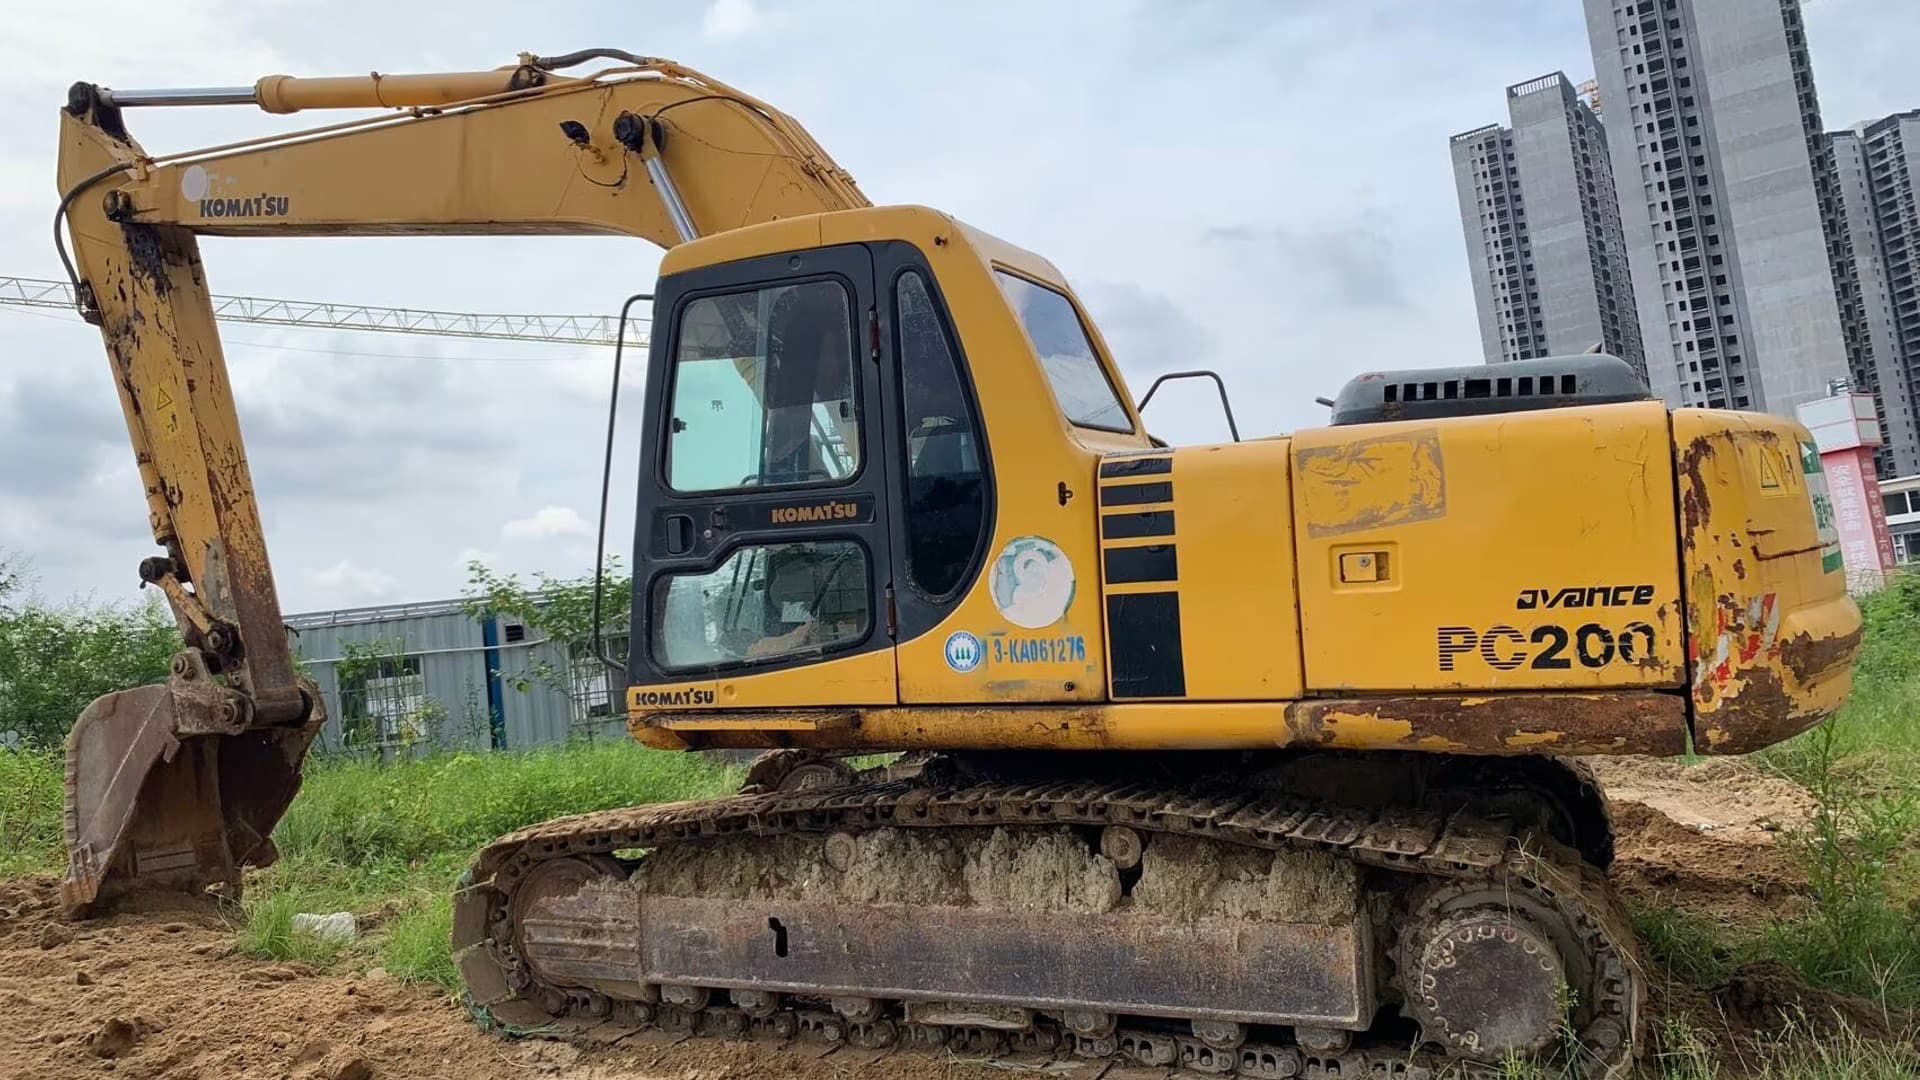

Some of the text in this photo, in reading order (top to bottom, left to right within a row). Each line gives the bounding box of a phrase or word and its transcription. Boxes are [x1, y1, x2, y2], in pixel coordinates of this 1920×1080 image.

[200, 193, 289, 218] KOMATSU
[772, 501, 857, 523] KOMATSU
[1516, 584, 1655, 610] avance
[993, 635, 1086, 664] 3-KA061276
[1437, 621, 1656, 672] PC200
[635, 687, 714, 706] KOMATSU
